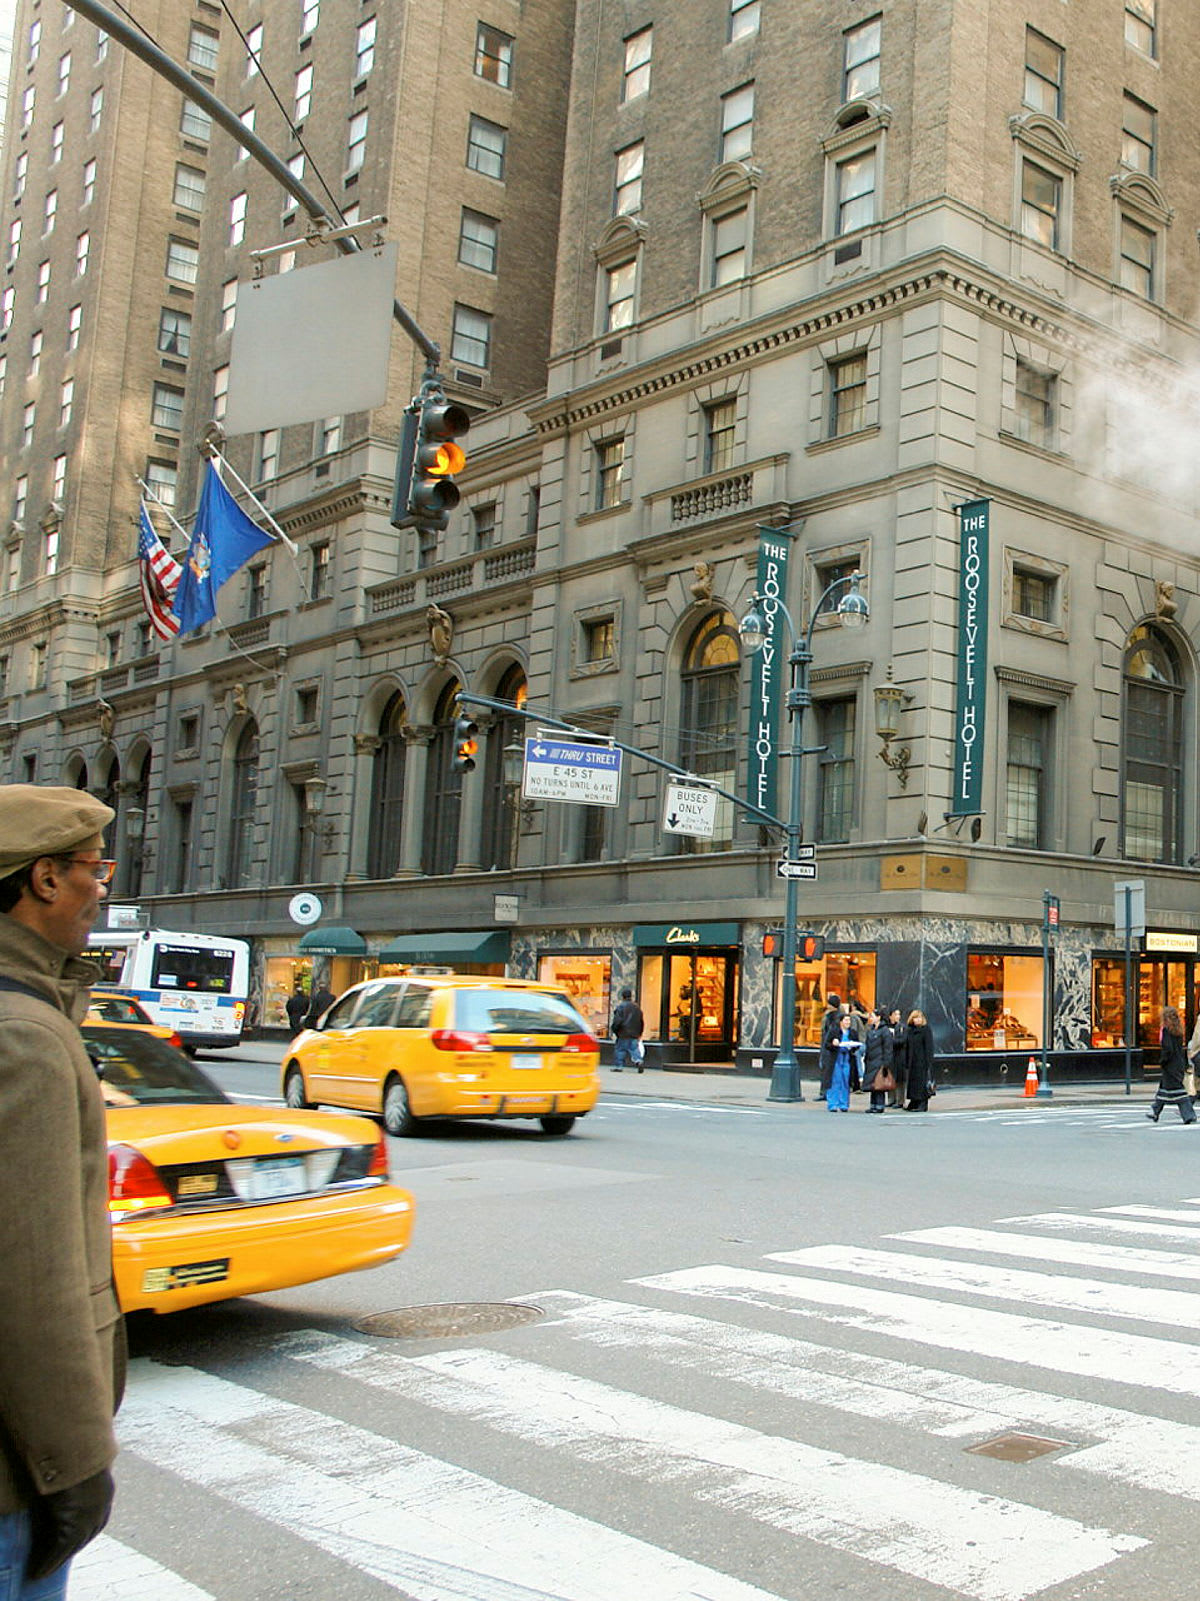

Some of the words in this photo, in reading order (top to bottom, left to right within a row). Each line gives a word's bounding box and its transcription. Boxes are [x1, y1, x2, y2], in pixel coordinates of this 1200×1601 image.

[963, 515, 986, 532] THE
[763, 543, 788, 561] THE
[965, 536, 980, 700] ROOSEVELT
[559, 749, 585, 761] THRU
[586, 752, 616, 765] STREET
[962, 707, 976, 799] HOTEL
[553, 767, 559, 776] E
[564, 768, 577, 778] 45
[581, 769, 594, 780] ST
[756, 722, 771, 809] HOTEL
[544, 778, 568, 788] TURNS
[570, 781, 590, 790] UNTIL
[601, 784, 613, 793] AVE
[677, 791, 708, 804] BUSES
[679, 803, 704, 815] ONLY
[1149, 937, 1196, 948] BOSTONIAN
